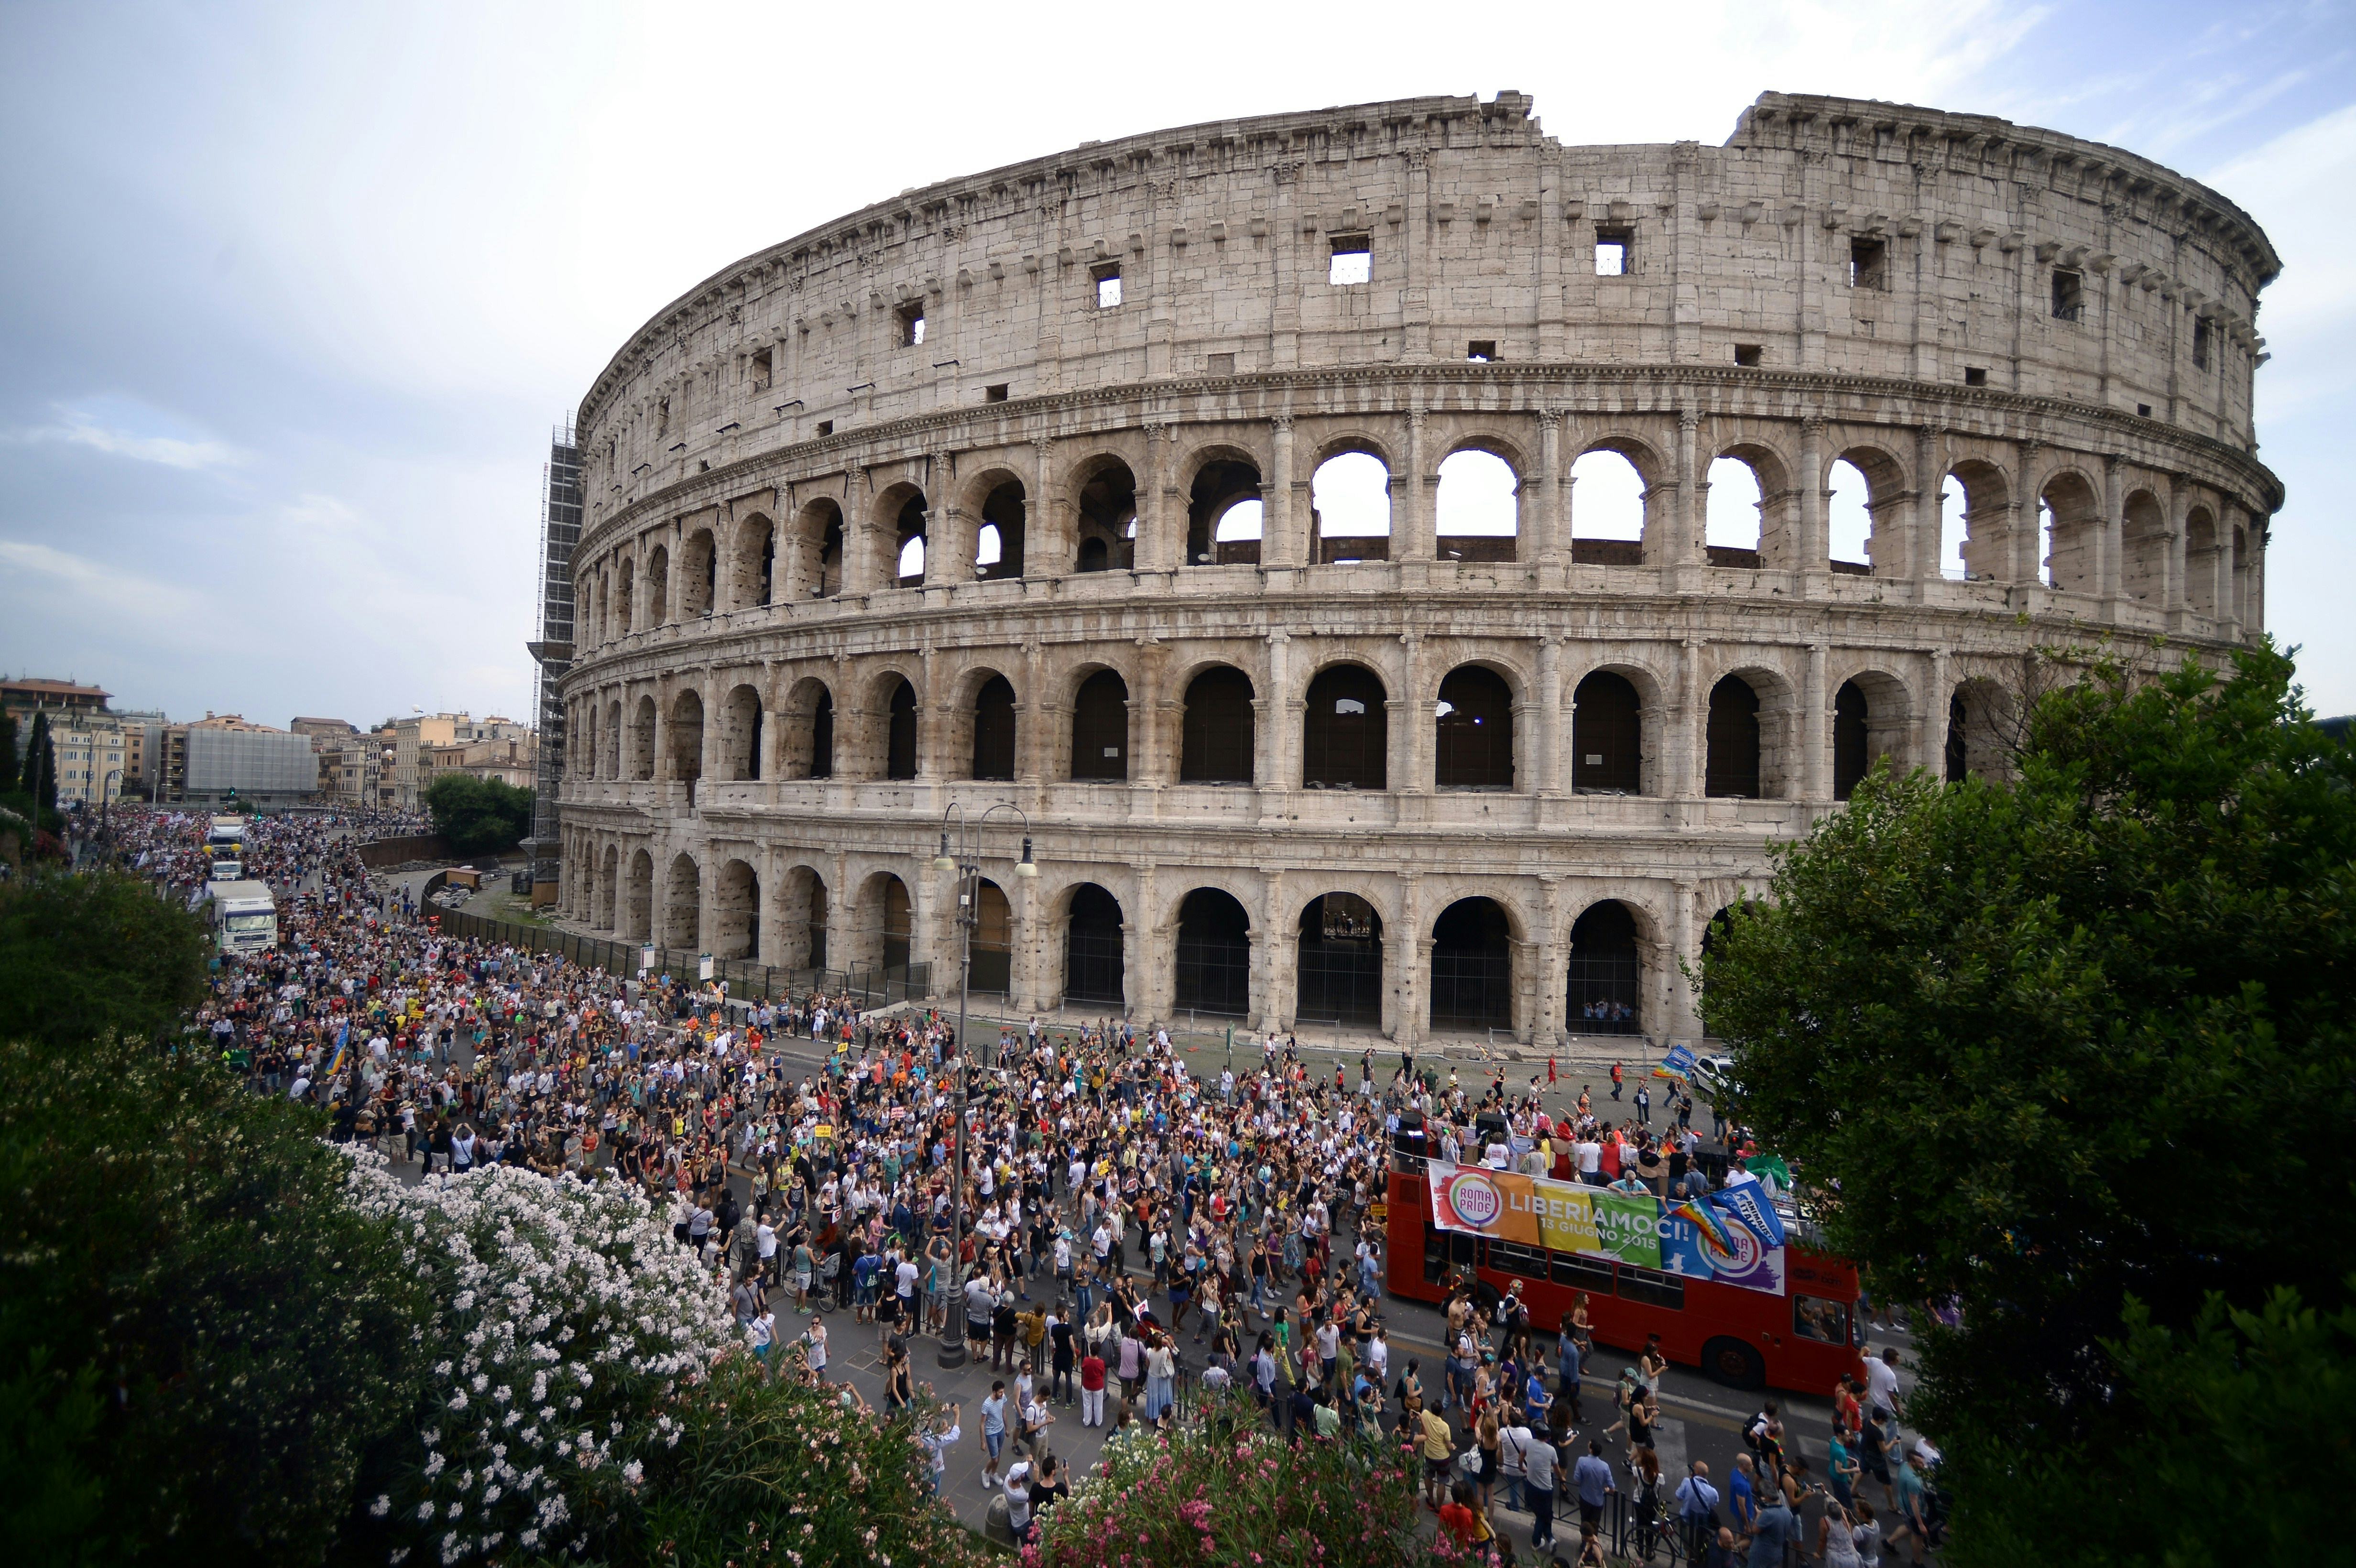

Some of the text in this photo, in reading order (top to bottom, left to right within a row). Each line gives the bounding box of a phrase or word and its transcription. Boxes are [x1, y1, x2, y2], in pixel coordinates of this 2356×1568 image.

[1460, 1188, 1491, 1202] ROMA
[1460, 1198, 1491, 1213] PRIDE
[1510, 1193, 1689, 1242] LIBERIAMOCI!
[1540, 1218, 1657, 1250] 13 GIUGNO 2015
